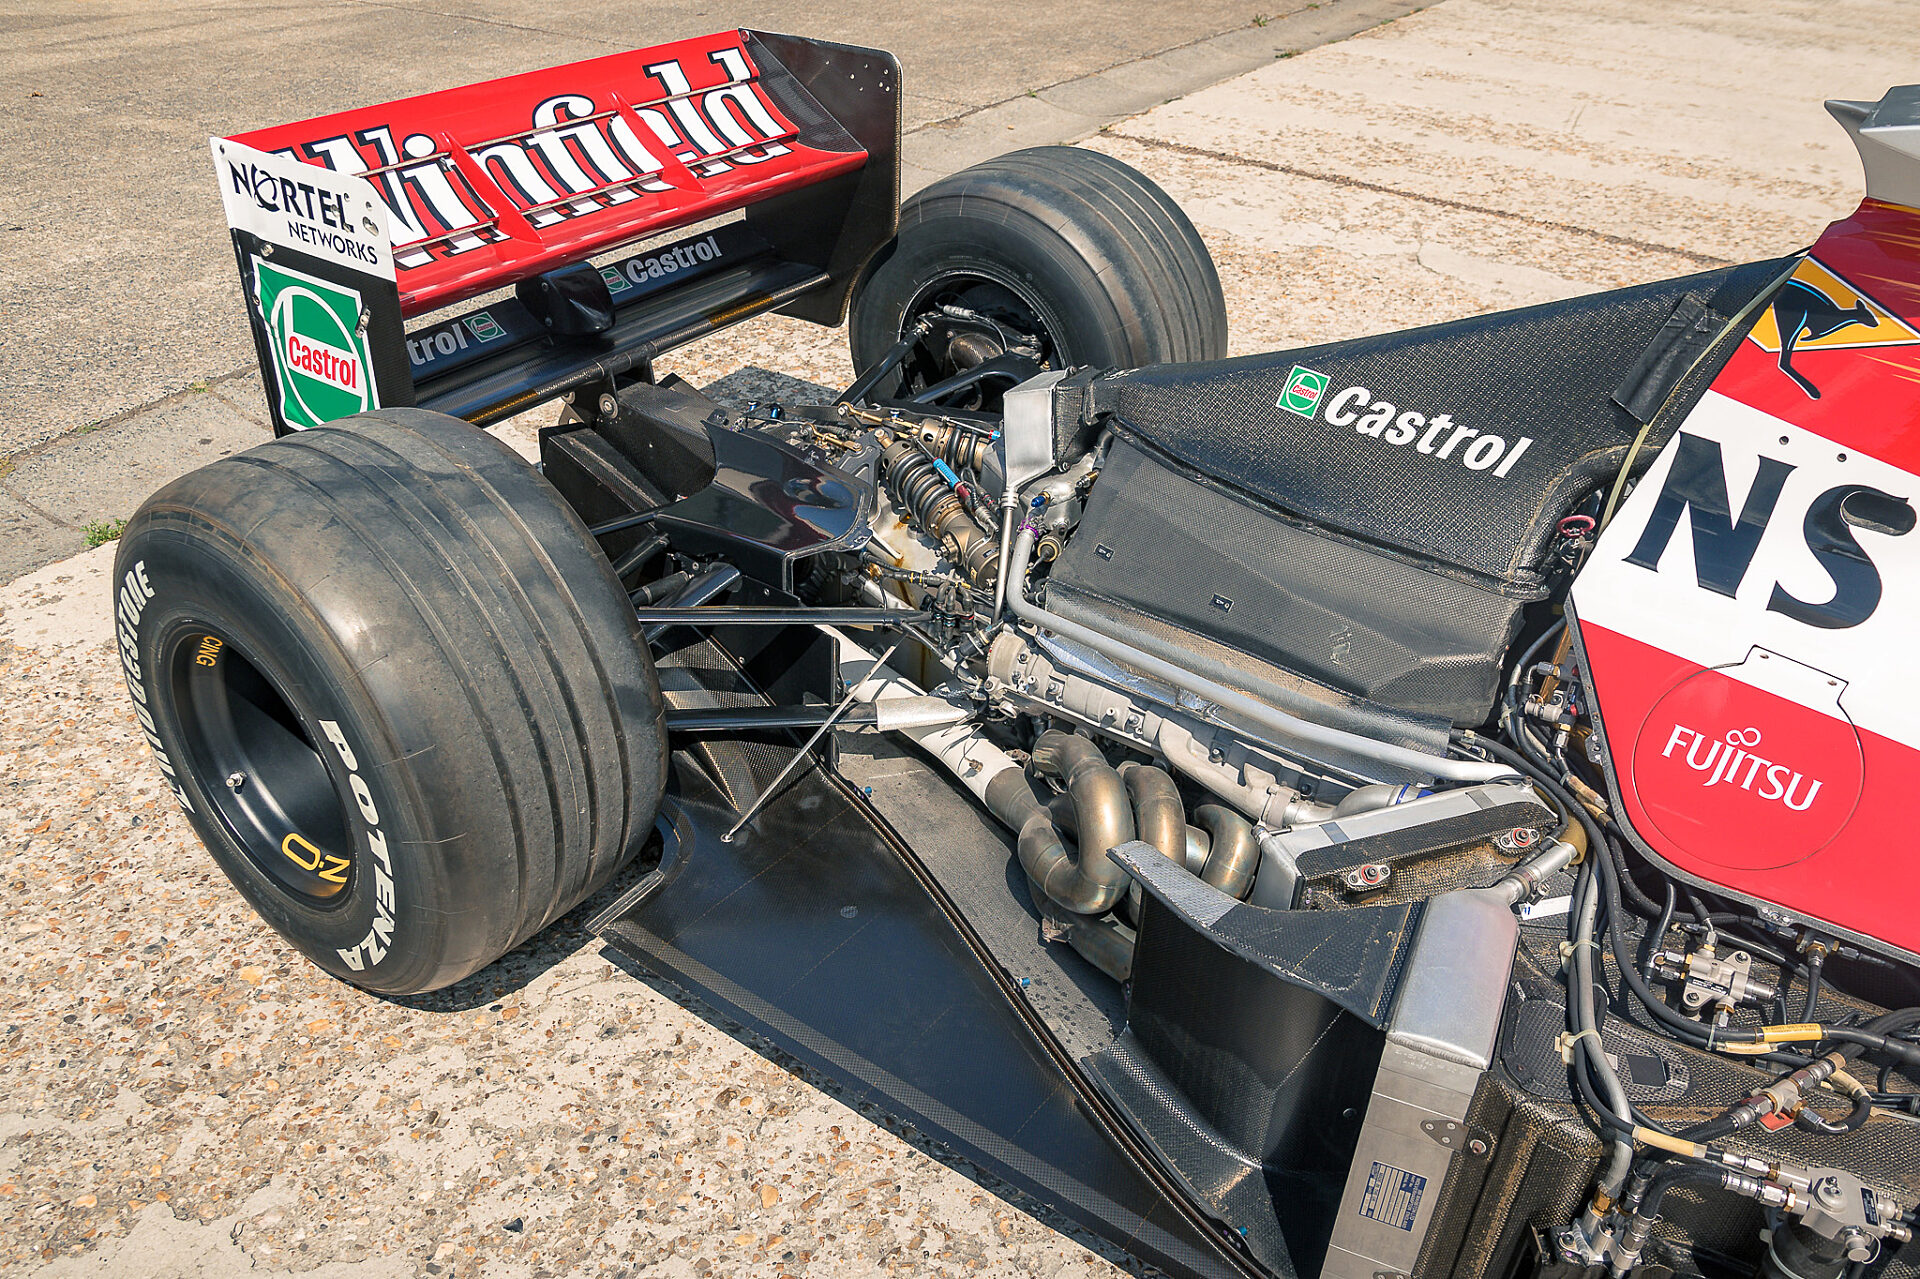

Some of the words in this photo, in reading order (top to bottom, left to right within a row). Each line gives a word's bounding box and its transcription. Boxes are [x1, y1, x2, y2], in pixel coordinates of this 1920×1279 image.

[229, 160, 355, 234] NORTEL
[288, 221, 379, 266] NETWORKS
[626, 236, 723, 284] Castrol
[289, 336, 357, 389] Castrol
[1292, 384, 1319, 400] Castrol
[1324, 385, 1534, 479] Castrol
[1621, 430, 1909, 630] NS
[196, 635, 224, 668] CING
[1660, 722, 1824, 811] FUJITSU
[318, 719, 396, 972] POTENZA
